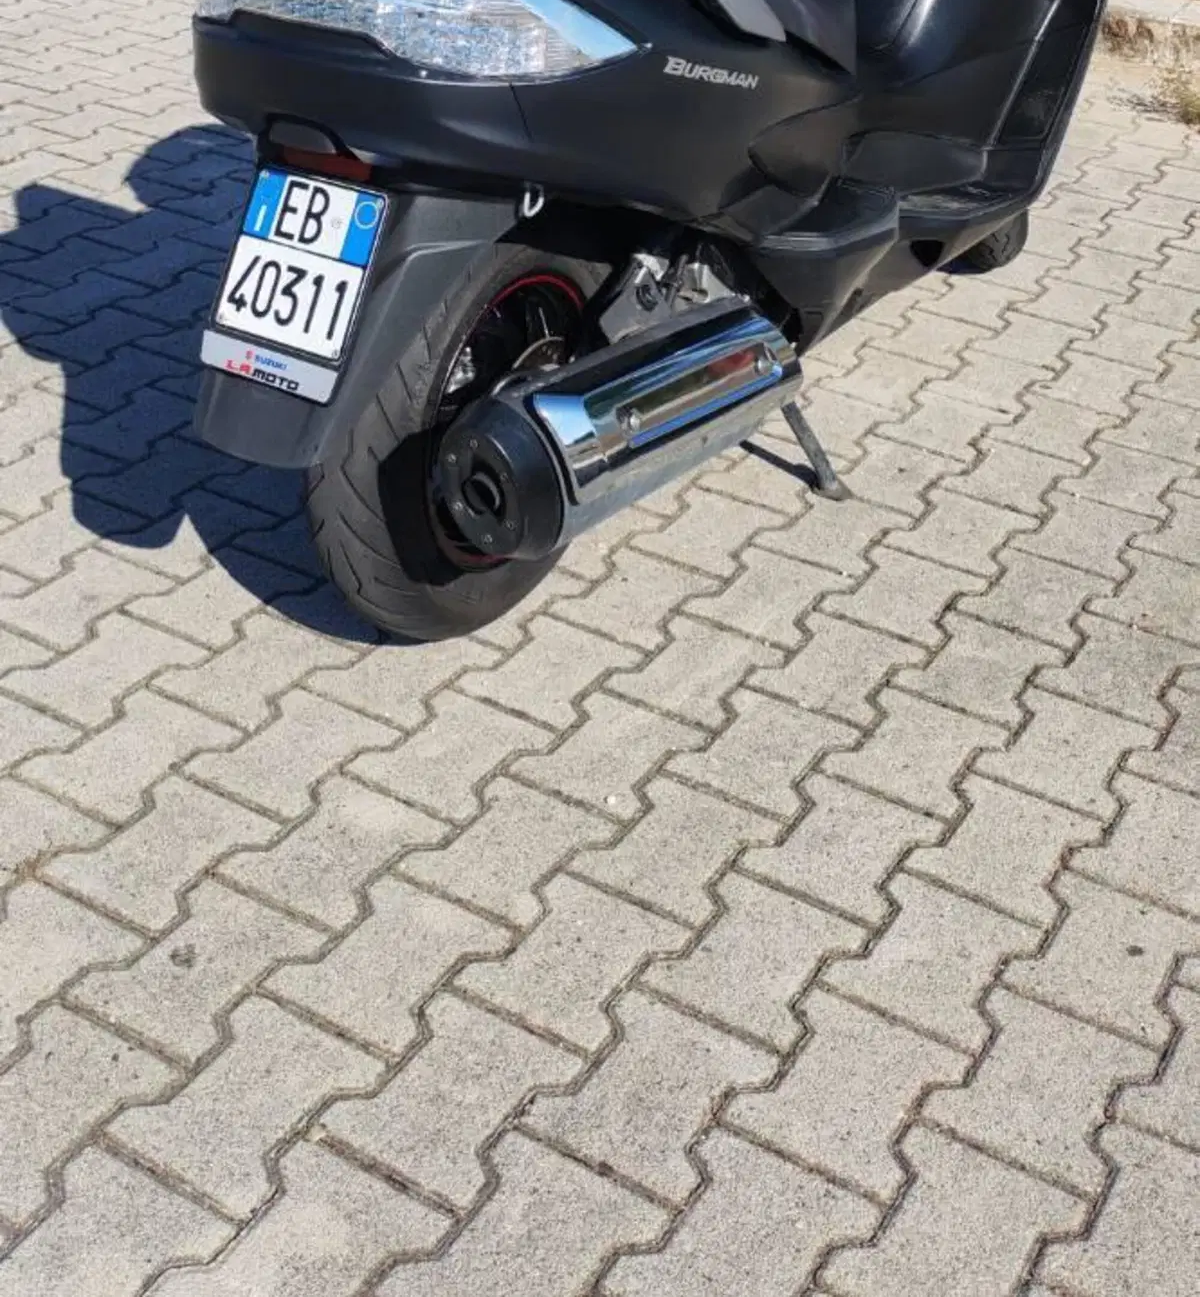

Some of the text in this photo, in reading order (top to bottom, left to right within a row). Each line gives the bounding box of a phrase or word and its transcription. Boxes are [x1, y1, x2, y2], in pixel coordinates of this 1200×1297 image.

[663, 55, 759, 89] BURGMAN
[254, 205, 268, 232] I
[273, 179, 331, 245] EB
[227, 255, 348, 340] 40311
